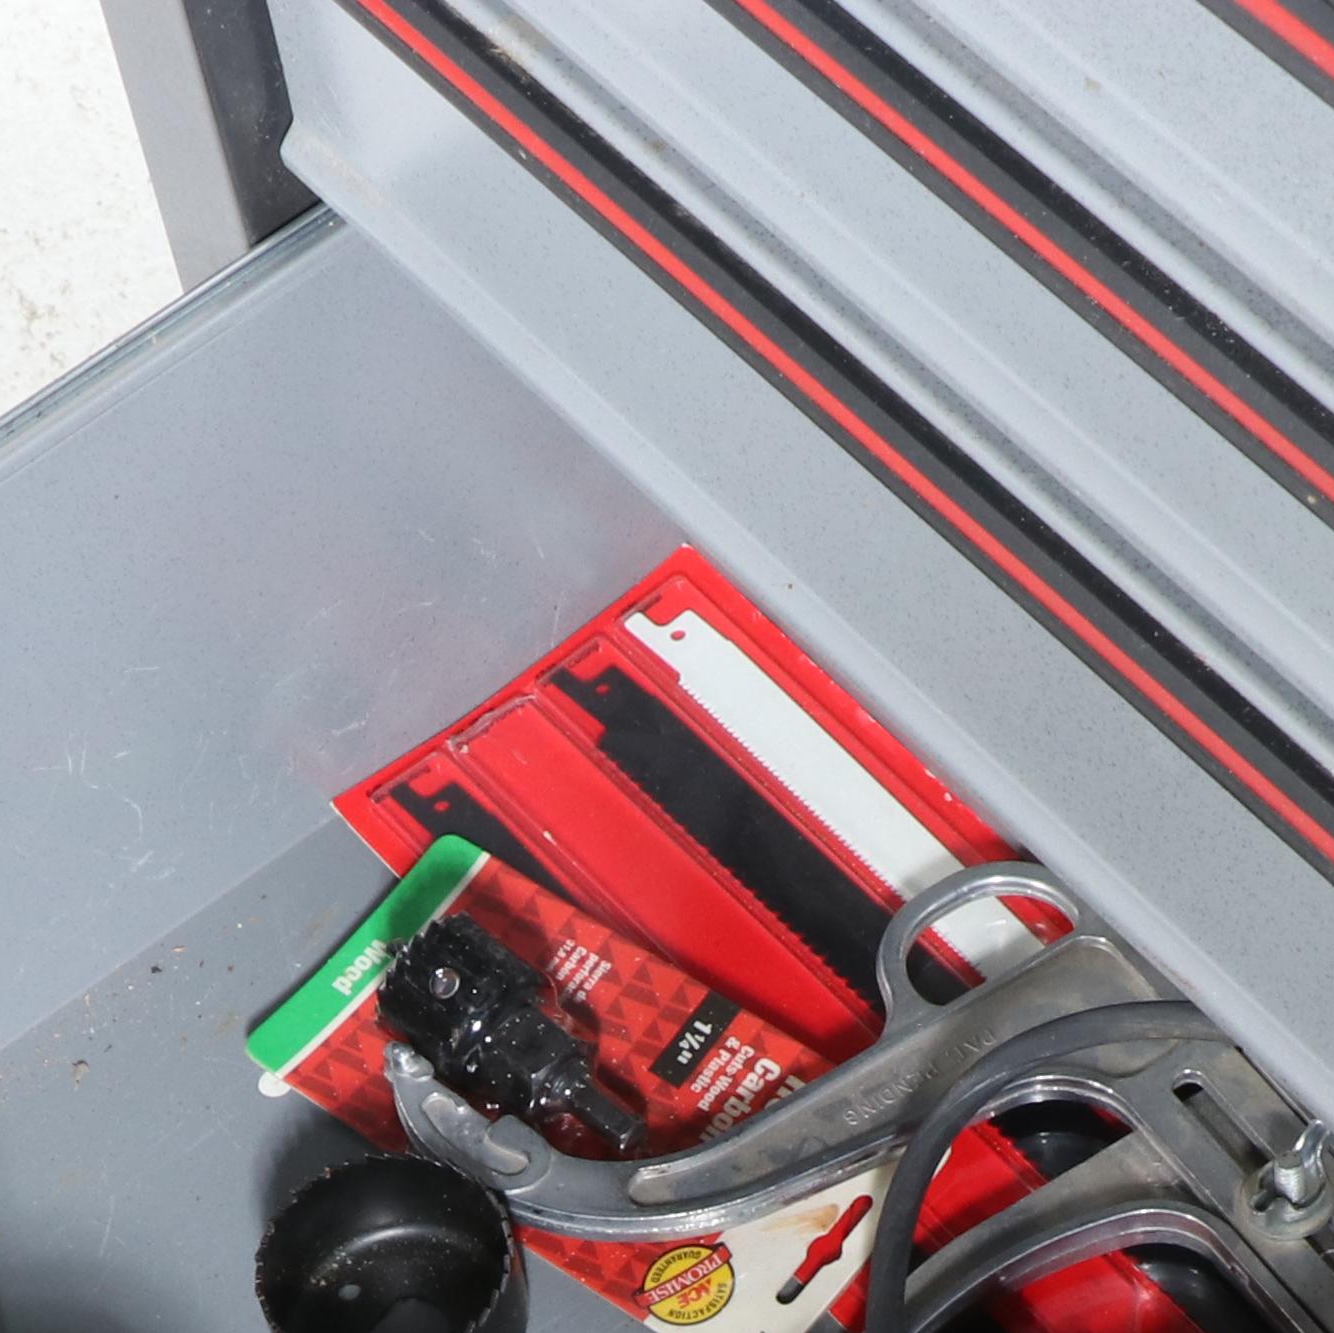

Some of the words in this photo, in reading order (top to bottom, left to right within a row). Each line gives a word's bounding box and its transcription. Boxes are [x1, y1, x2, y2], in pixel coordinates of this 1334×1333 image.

[330, 938, 390, 997] Wood
[723, 1042, 755, 1077] Cuts
[724, 1035, 740, 1051] &
[688, 1047, 732, 1095] Plastic
[695, 1072, 732, 1113] Wood
[643, 1253, 722, 1303] PROMISE
[651, 1252, 701, 1282] GUARANTEED
[667, 1283, 727, 1319] SATISFACTION
[675, 1278, 710, 1309] ACE
